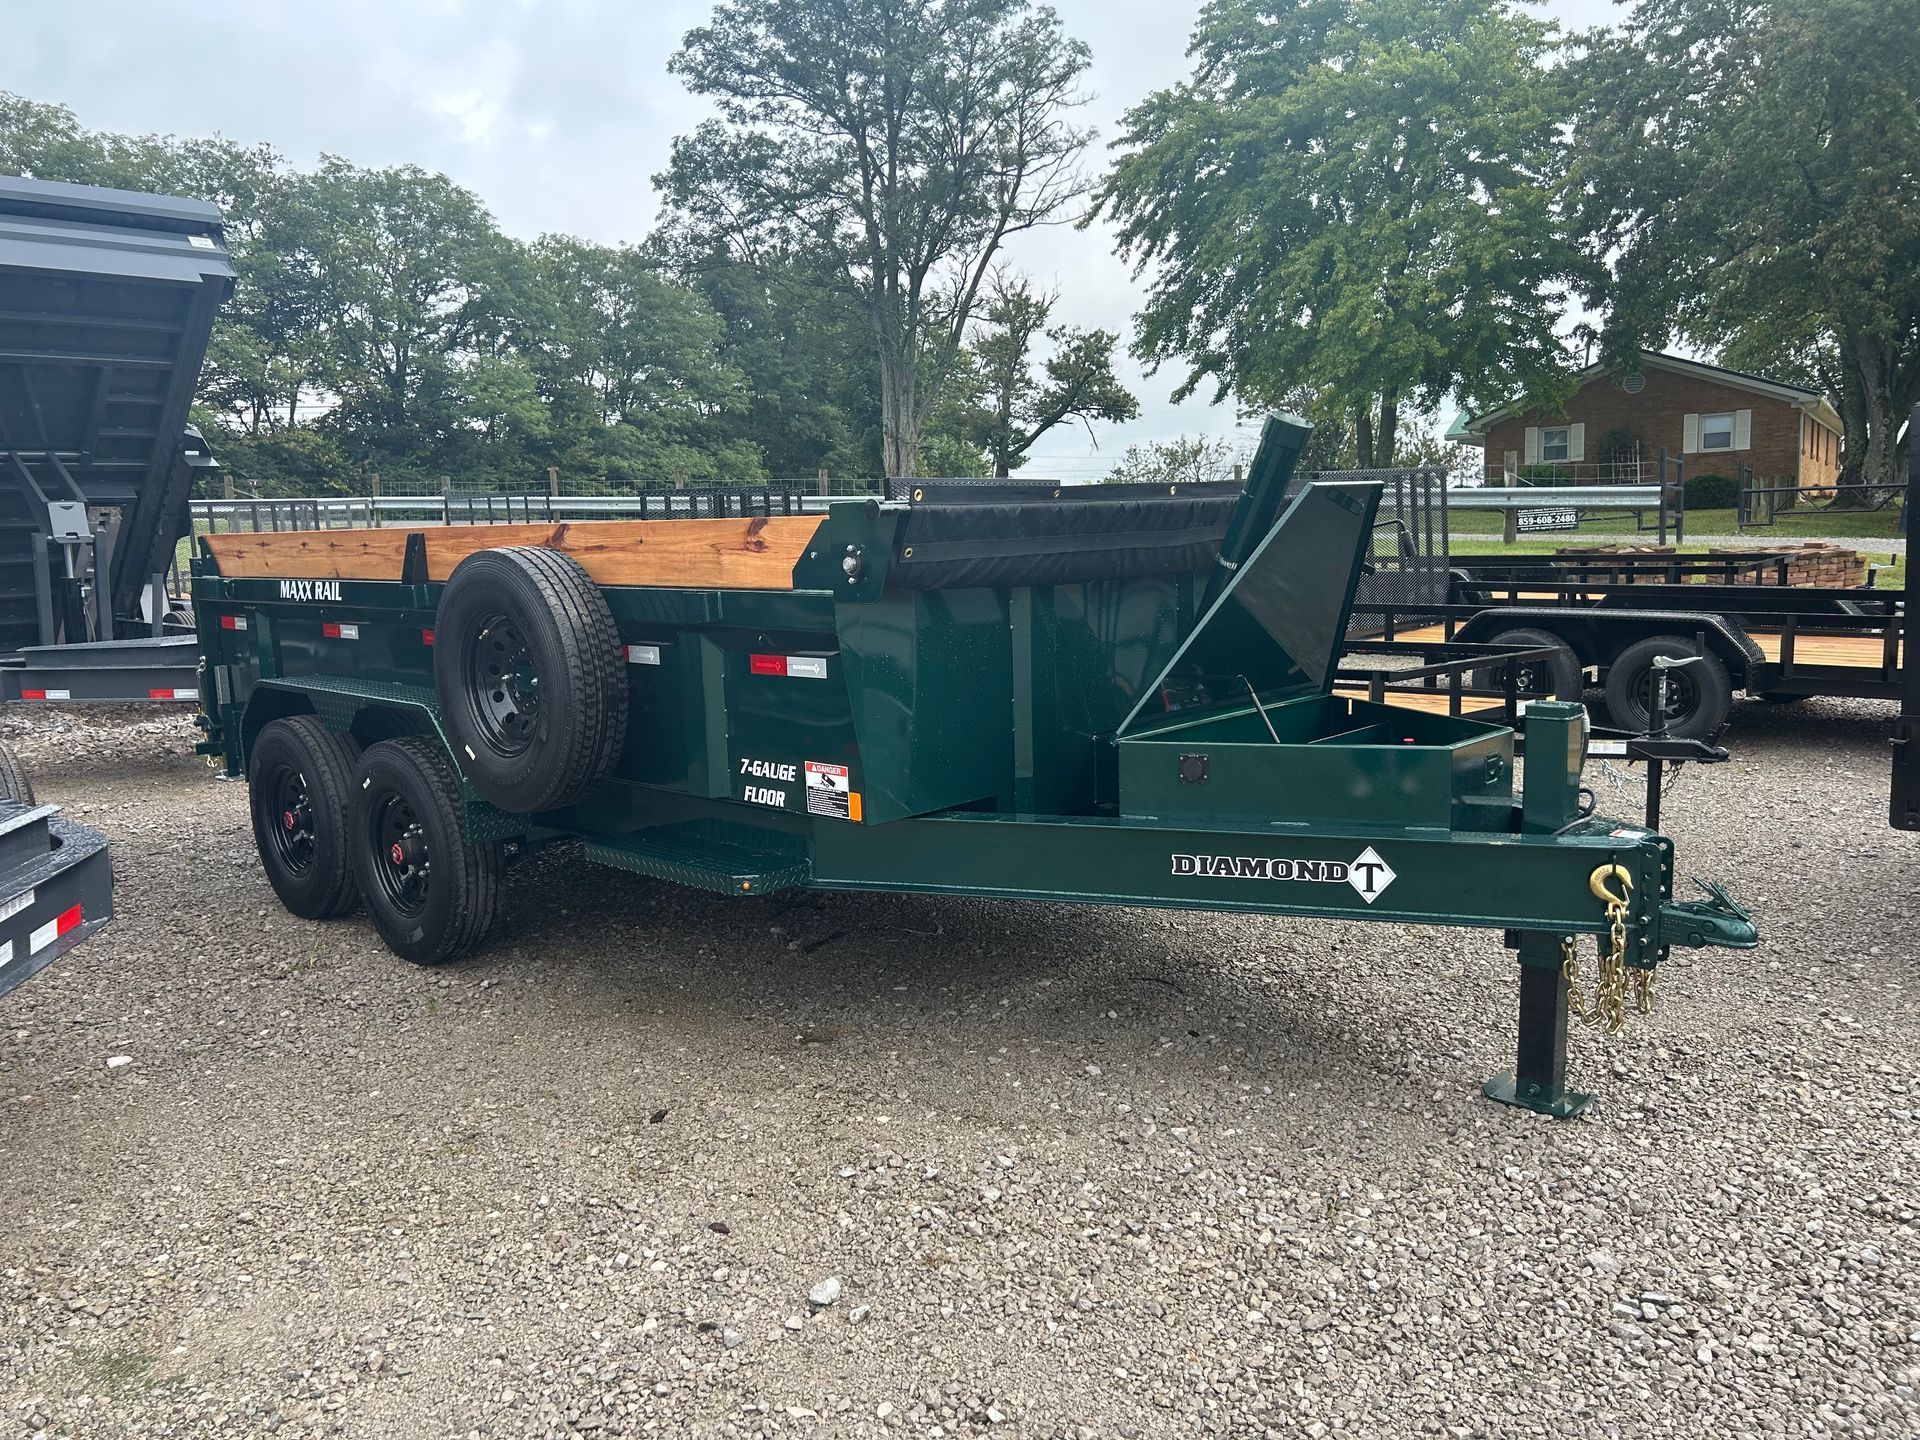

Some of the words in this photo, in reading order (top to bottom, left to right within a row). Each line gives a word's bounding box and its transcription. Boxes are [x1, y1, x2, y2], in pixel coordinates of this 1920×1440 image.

[1518, 514, 1576, 525] 859-608-2480
[280, 580, 313, 602] MAXX
[314, 581, 343, 601] RAIL
[740, 758, 797, 782] 7-GAUGE
[816, 764, 842, 775] DANGER
[743, 785, 786, 808] FLOOR
[1172, 854, 1349, 883] DIAMOND
[1354, 862, 1385, 893] T
